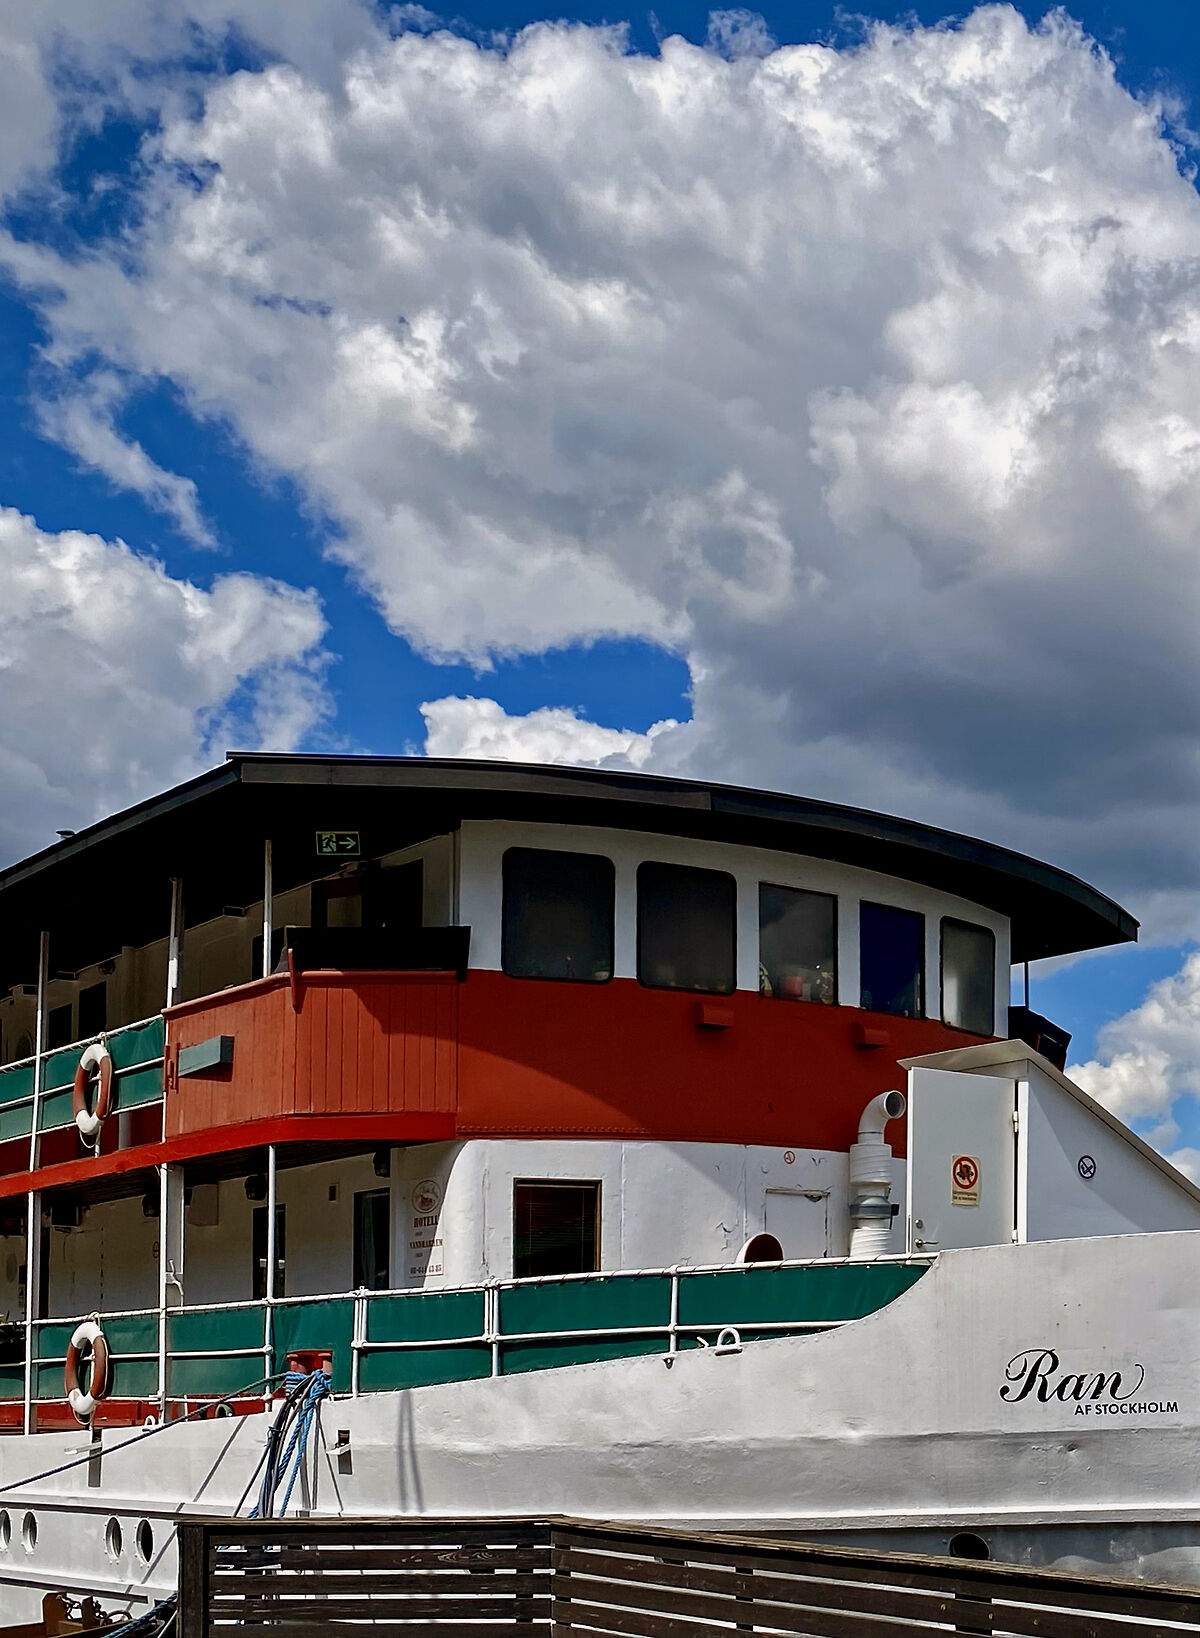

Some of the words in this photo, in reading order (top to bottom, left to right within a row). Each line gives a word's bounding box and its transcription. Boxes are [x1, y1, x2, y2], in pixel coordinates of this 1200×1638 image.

[1000, 1348, 1145, 1403] Ran
[1074, 1404, 1093, 1416] AF
[1095, 1401, 1179, 1415] STOCKHOLM
